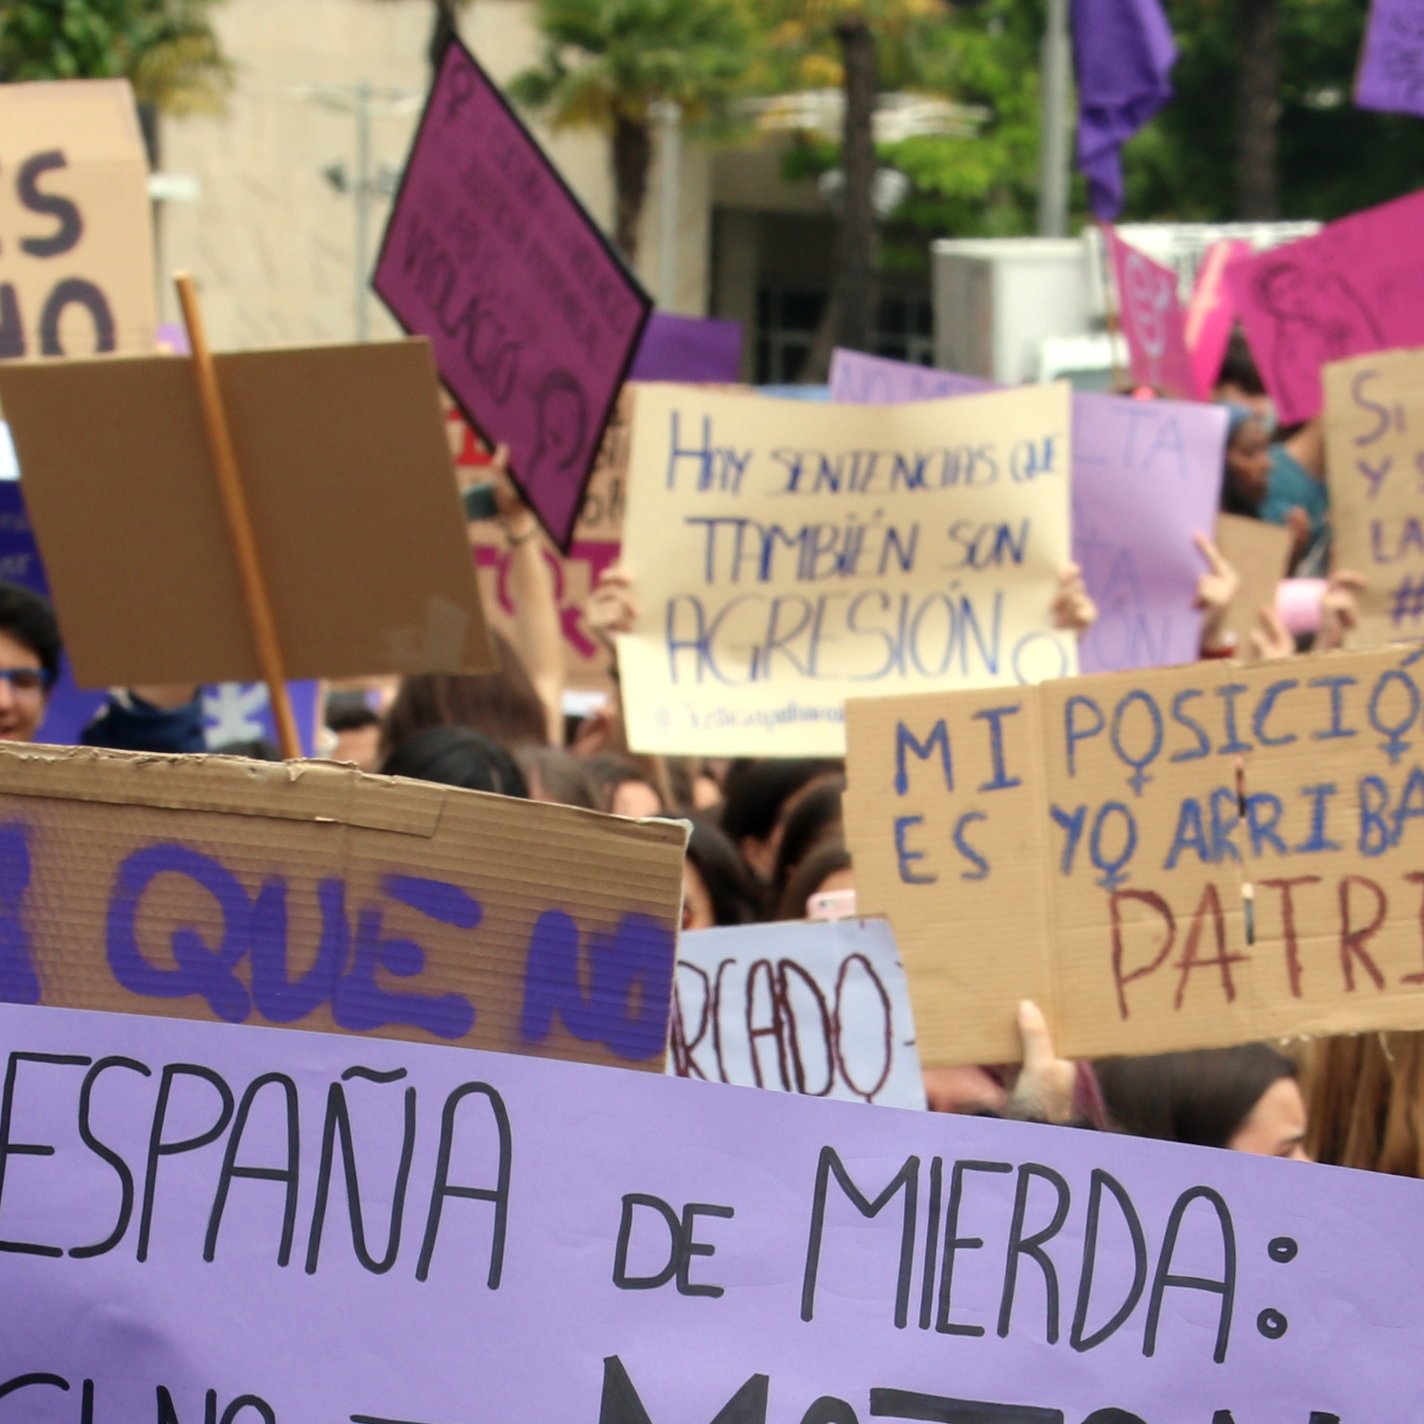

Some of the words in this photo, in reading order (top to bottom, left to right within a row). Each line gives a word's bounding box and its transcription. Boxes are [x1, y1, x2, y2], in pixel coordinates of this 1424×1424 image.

[1355, 456, 1393, 500] Y
[938, 516, 1032, 574] SON
[665, 580, 1004, 687] AGRESIÓN
[893, 705, 1025, 796] MI
[897, 808, 991, 887] ES
[1051, 803, 1139, 889] YO
[105, 841, 485, 1026] QUE
[520, 907, 680, 1063] NO
[612, 1192, 735, 1298] DE
[801, 1145, 1300, 1364] MIERDA:
